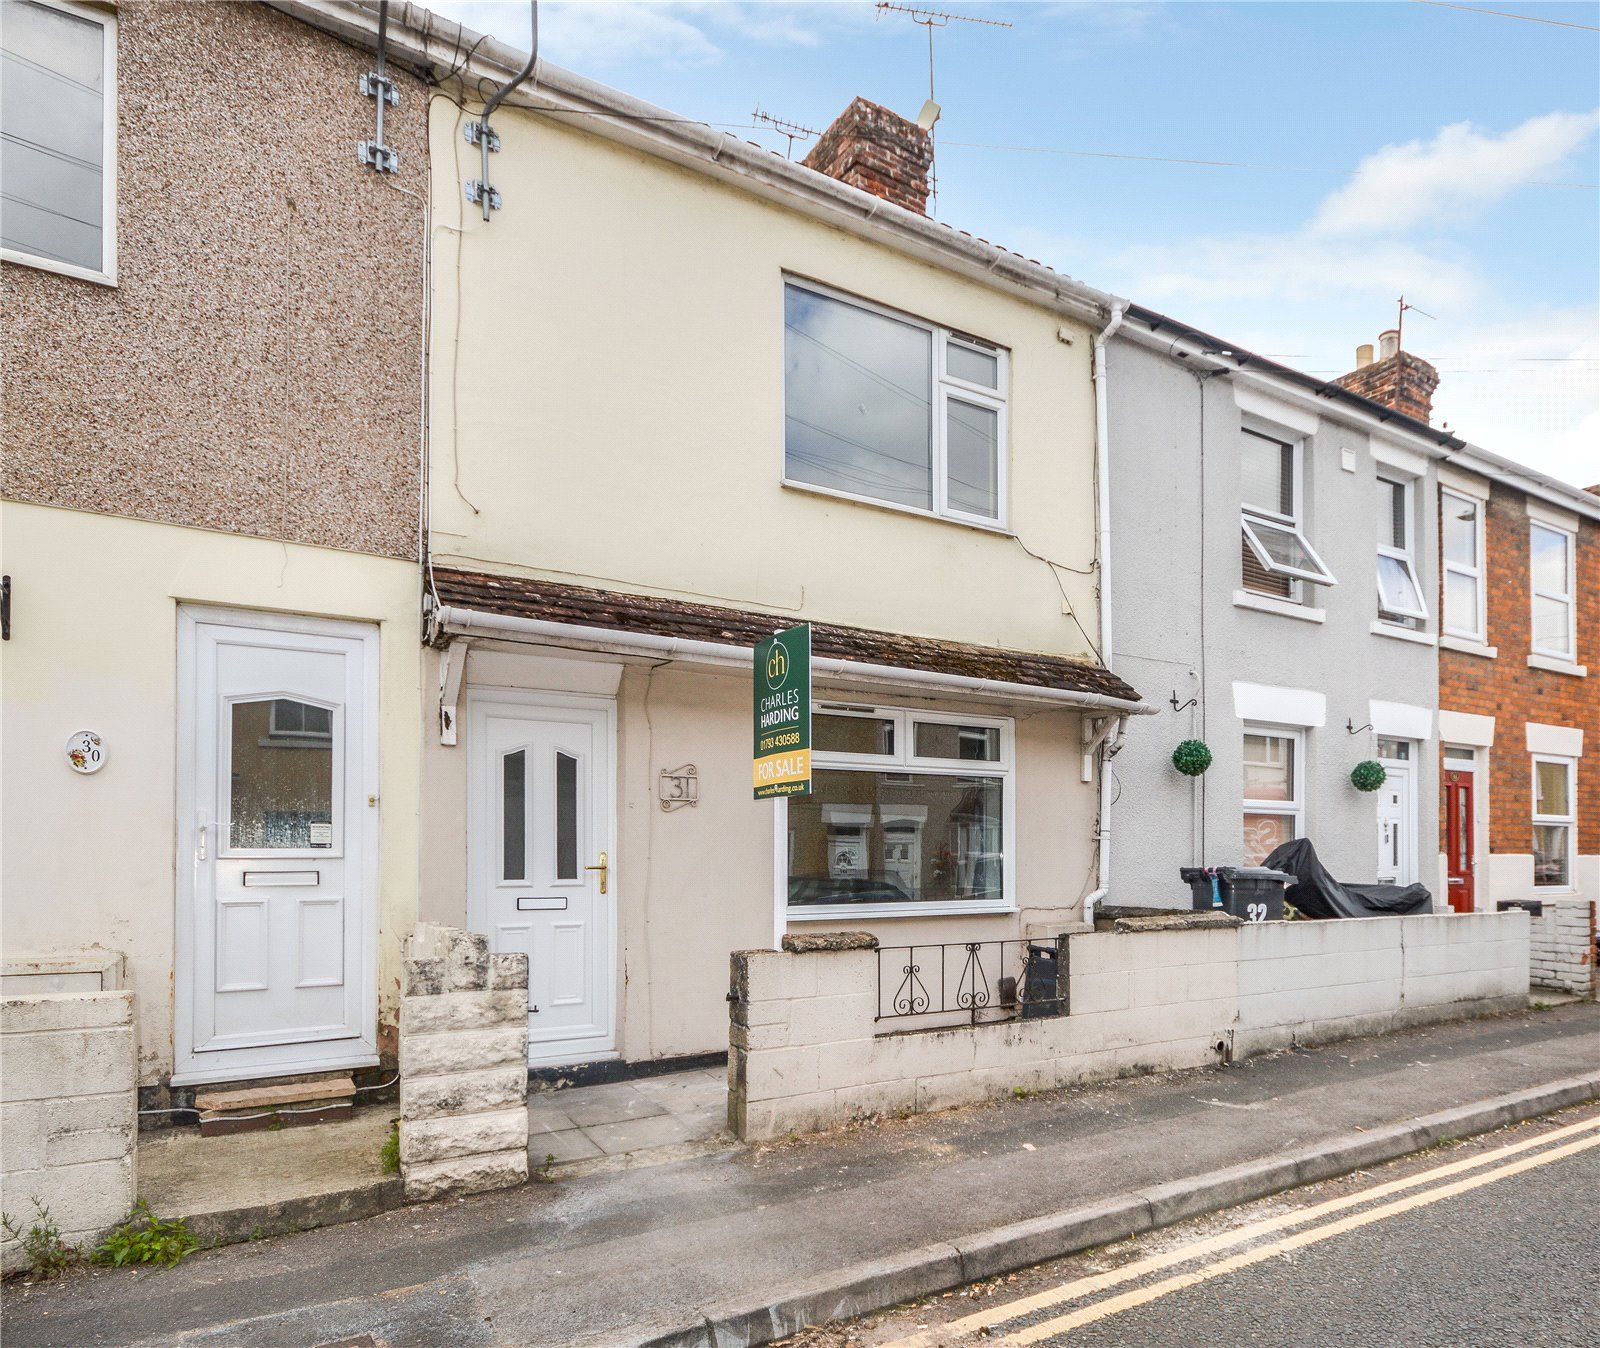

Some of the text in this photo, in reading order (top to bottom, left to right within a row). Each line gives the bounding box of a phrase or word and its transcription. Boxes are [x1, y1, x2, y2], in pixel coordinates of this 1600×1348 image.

[761, 688, 798, 713] CHARLES
[761, 706, 799, 728] HARDING
[82, 740, 100, 762] 30
[760, 732, 800, 751] 01793 430588
[758, 757, 804, 781] FOR SALE
[670, 776, 689, 799] 31
[1247, 903, 1267, 922] 32
